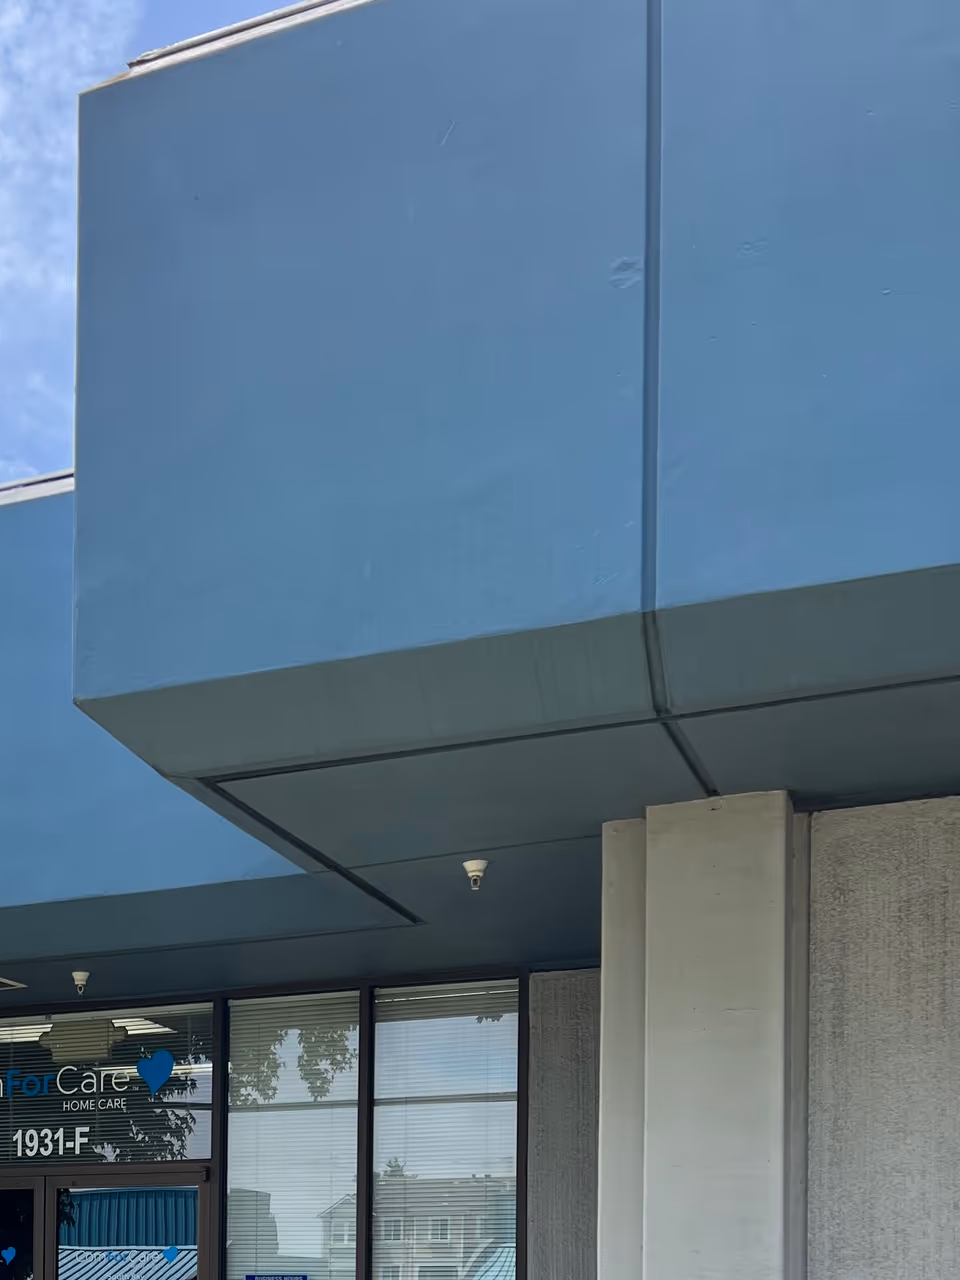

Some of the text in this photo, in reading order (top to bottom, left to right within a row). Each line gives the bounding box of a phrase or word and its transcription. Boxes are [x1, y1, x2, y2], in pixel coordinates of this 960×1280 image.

[62, 1098, 127, 1112] HOME CARE
[12, 1126, 90, 1157] 1931-F
